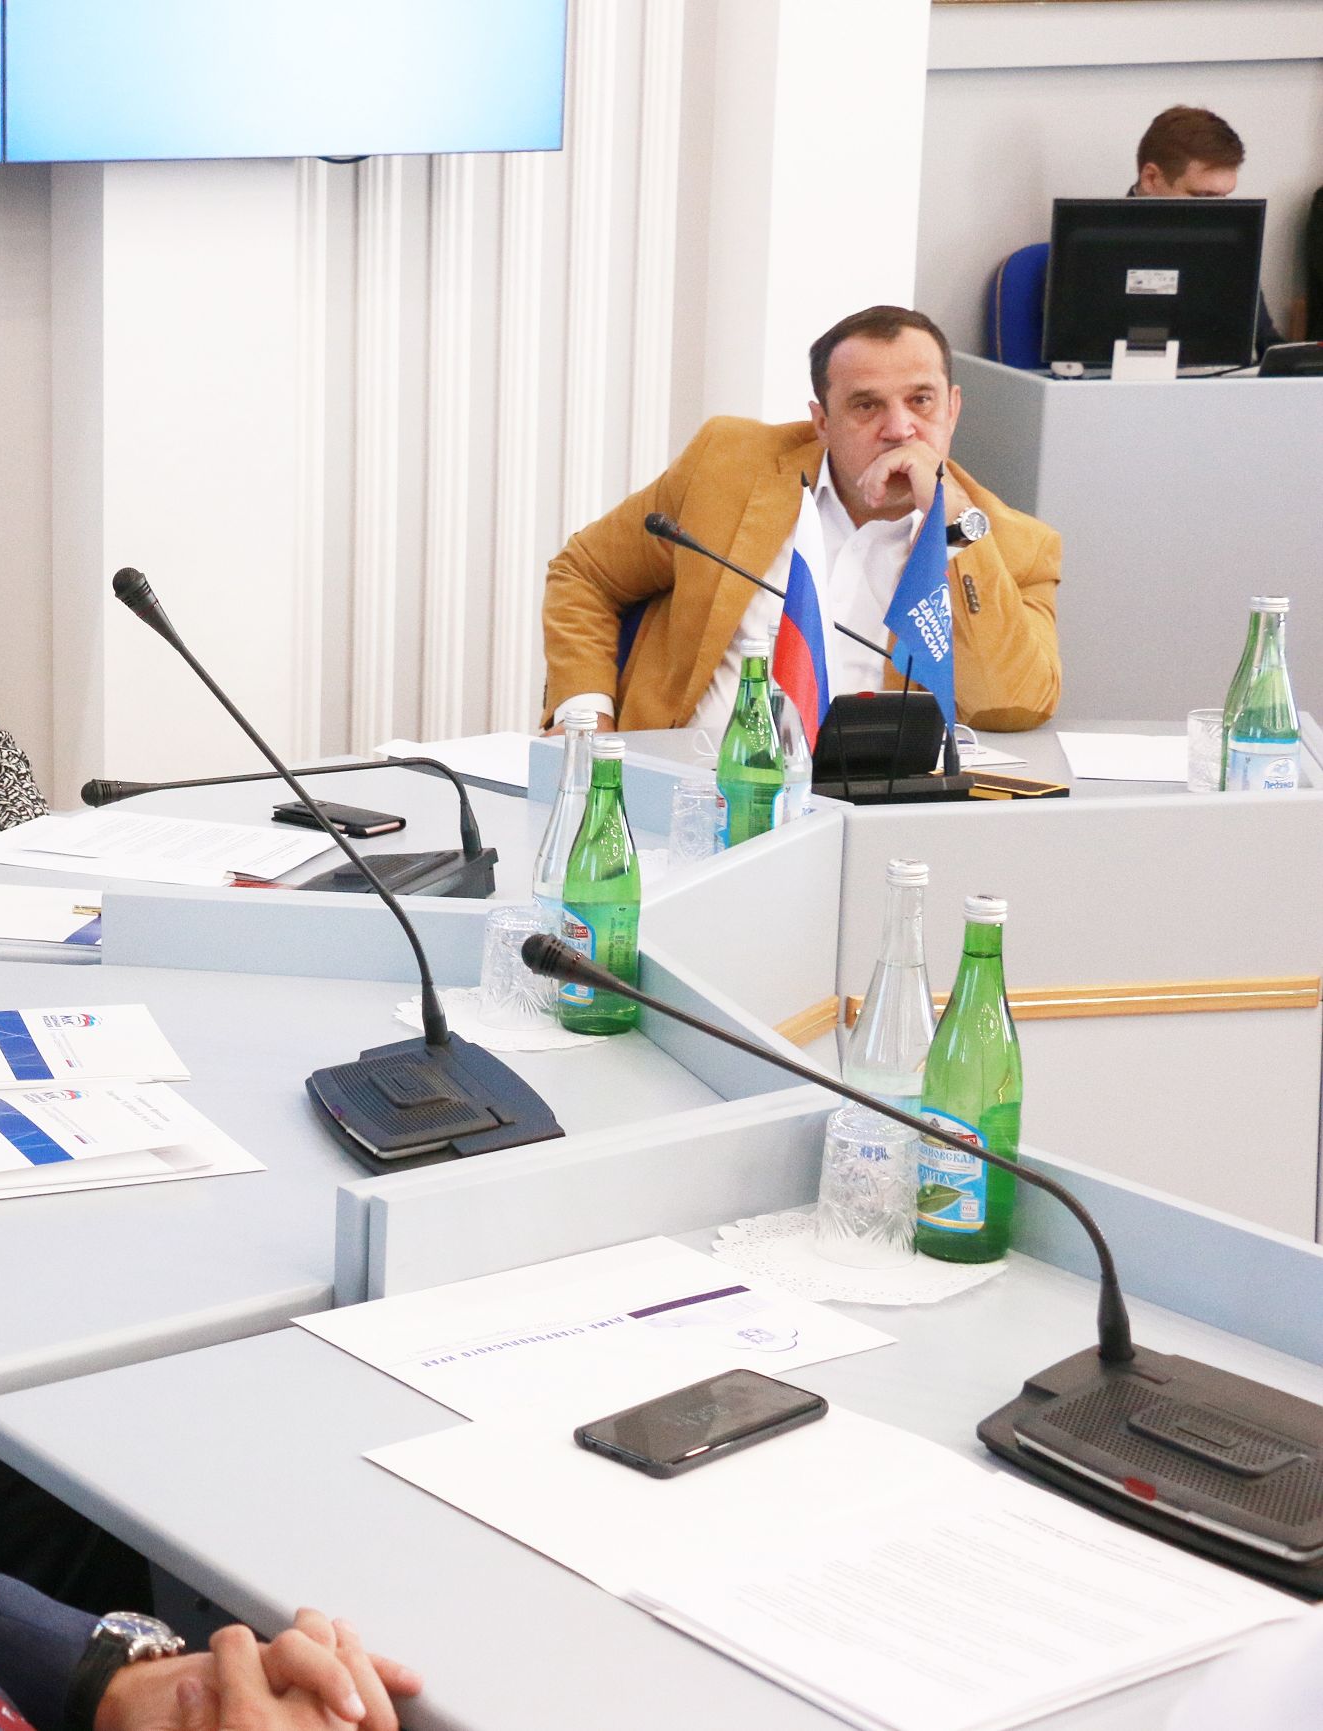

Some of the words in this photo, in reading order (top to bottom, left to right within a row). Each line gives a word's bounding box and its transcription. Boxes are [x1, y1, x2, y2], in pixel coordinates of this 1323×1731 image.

[908, 608, 943, 662] РОССИЯ
[918, 599, 949, 653] ЕДИНАЯ
[588, 1316, 625, 1330] ДУМА
[461, 1327, 585, 1359] СТАВРОПОЛЬСКОГО
[421, 1355, 457, 1368] КРАЯ
